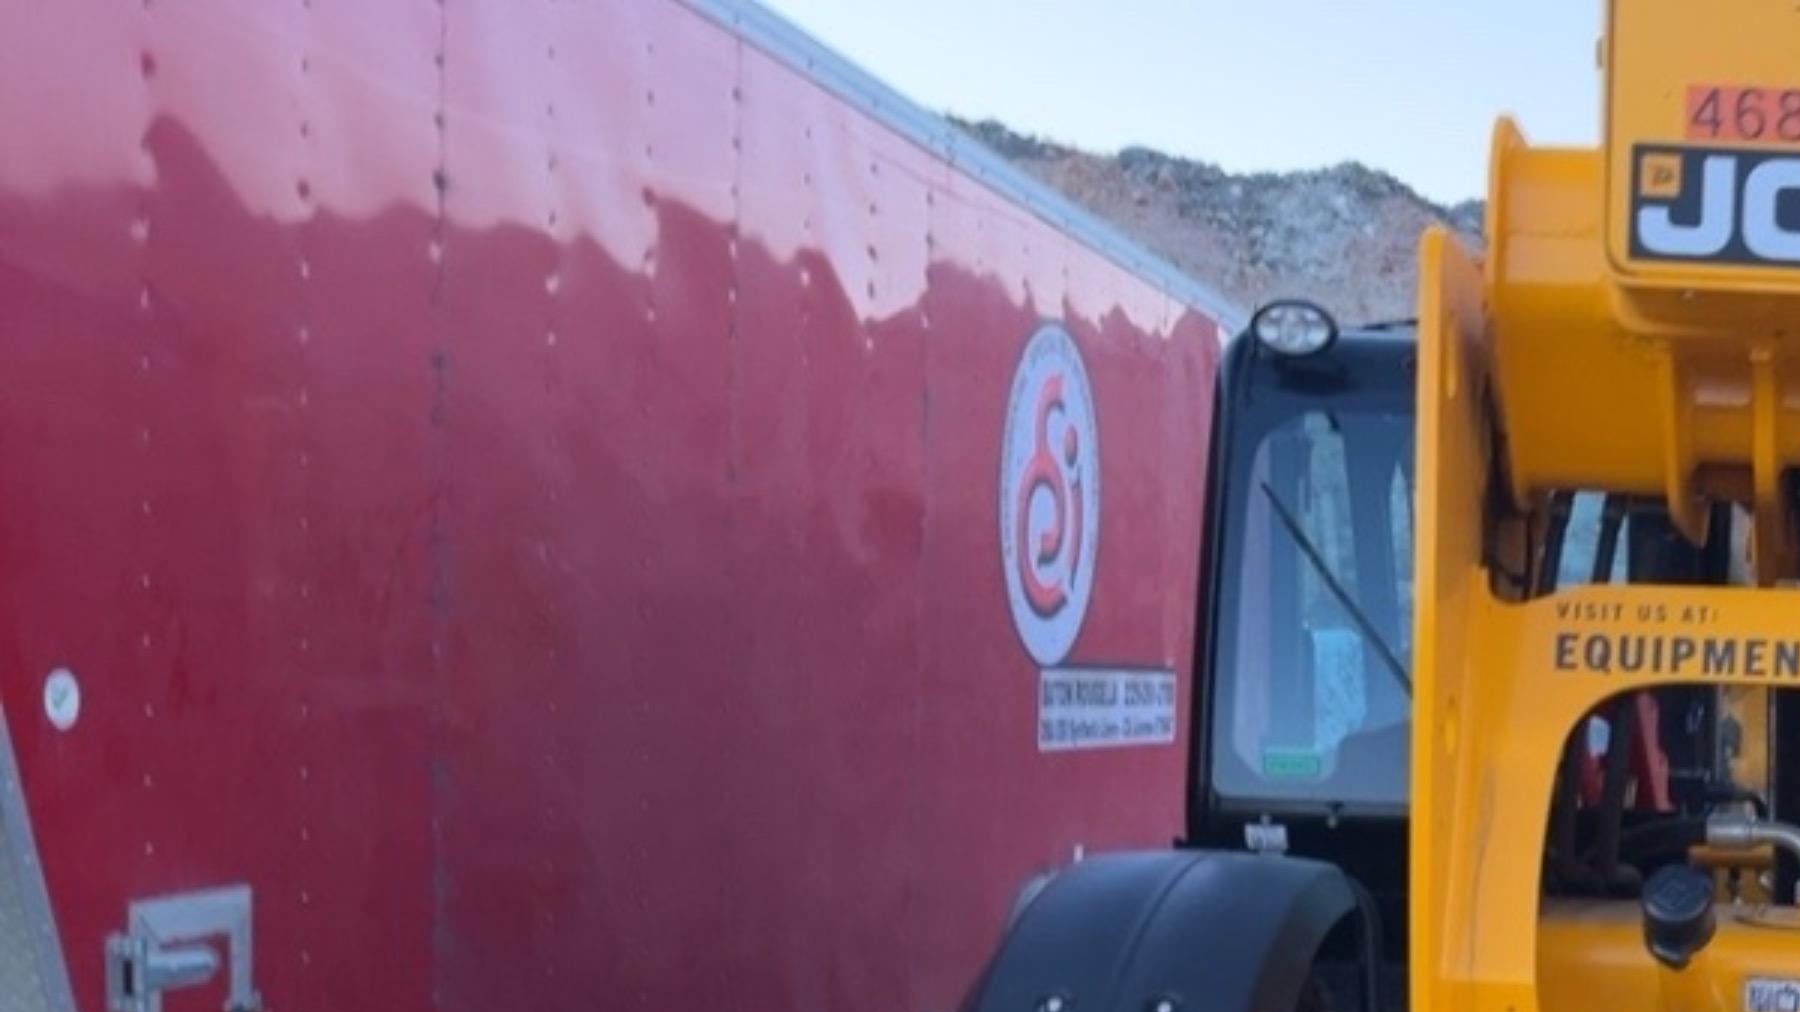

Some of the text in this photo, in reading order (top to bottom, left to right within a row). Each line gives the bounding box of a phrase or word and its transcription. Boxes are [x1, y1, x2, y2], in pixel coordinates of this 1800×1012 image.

[1556, 603, 1718, 624] VISIT US AT:
